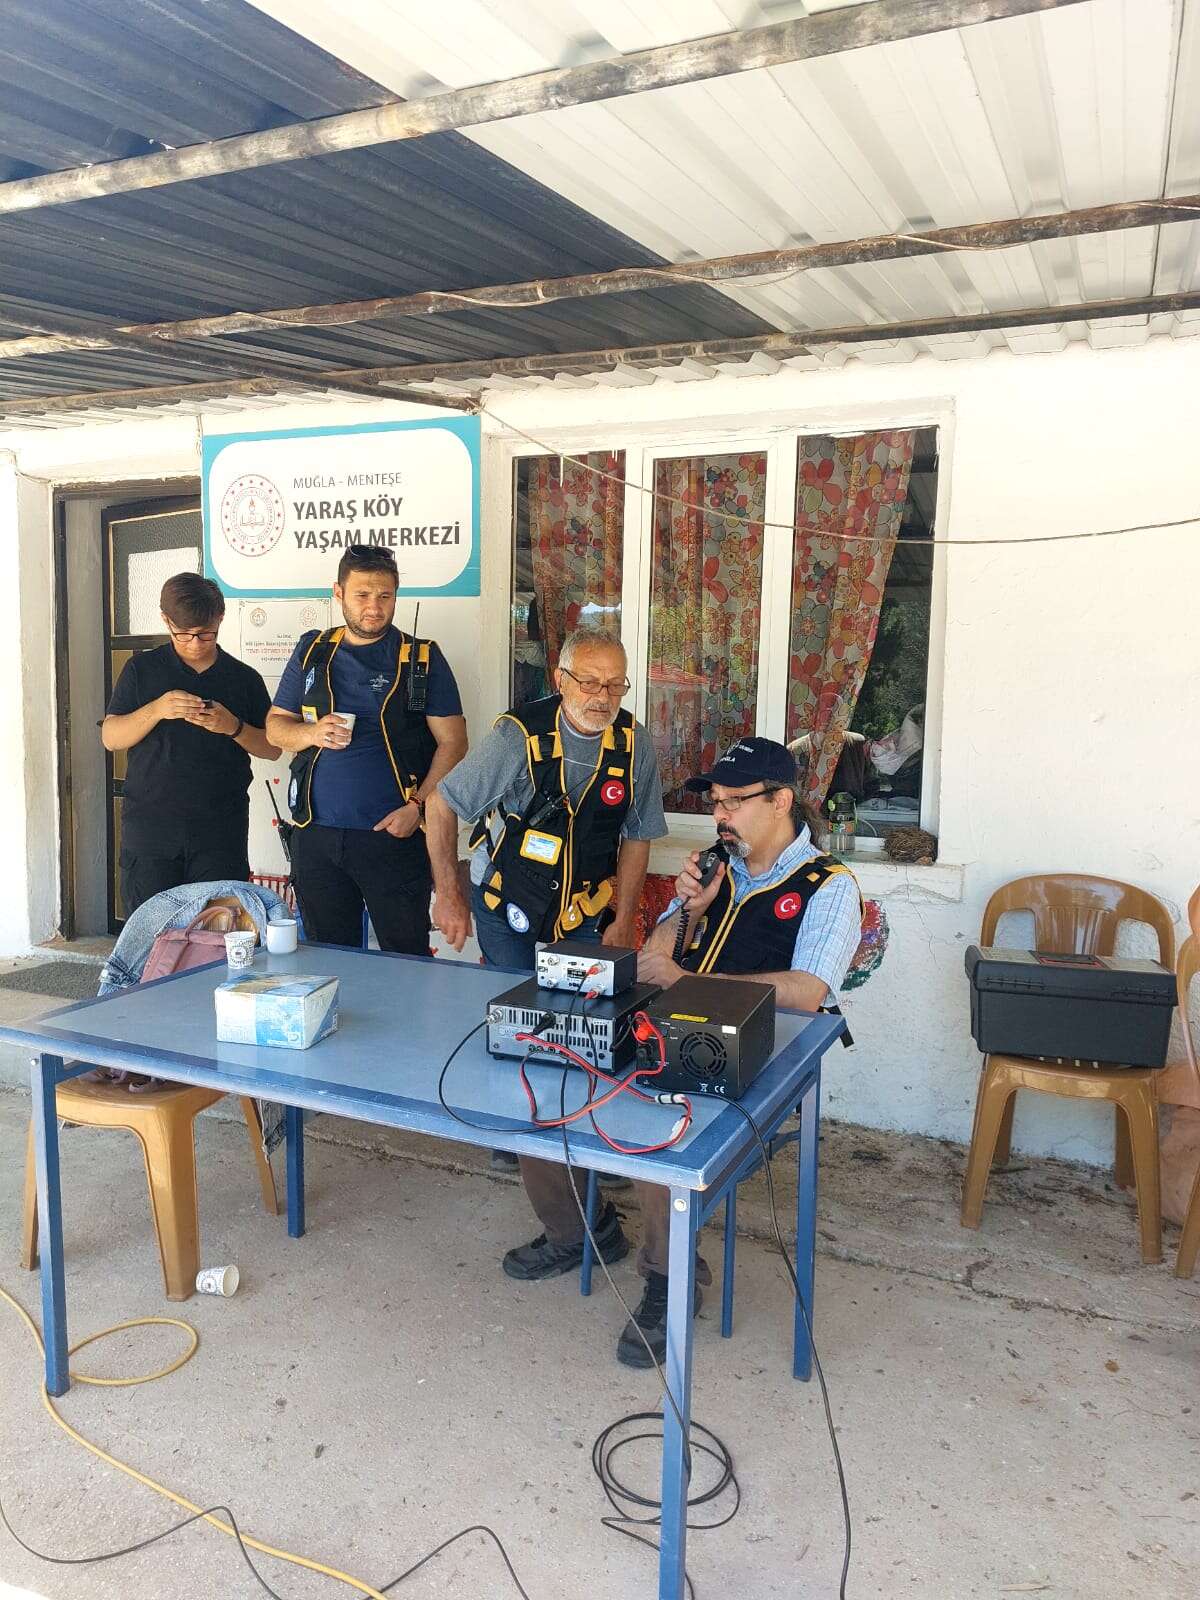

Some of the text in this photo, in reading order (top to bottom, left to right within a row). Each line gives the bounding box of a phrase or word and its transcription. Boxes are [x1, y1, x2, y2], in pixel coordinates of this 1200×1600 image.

[347, 472, 402, 487] MENTEŞE
[293, 499, 358, 524] YARAŞ
[363, 493, 404, 518] KÖY
[294, 521, 460, 553] YAŞAM MERKEZİ
